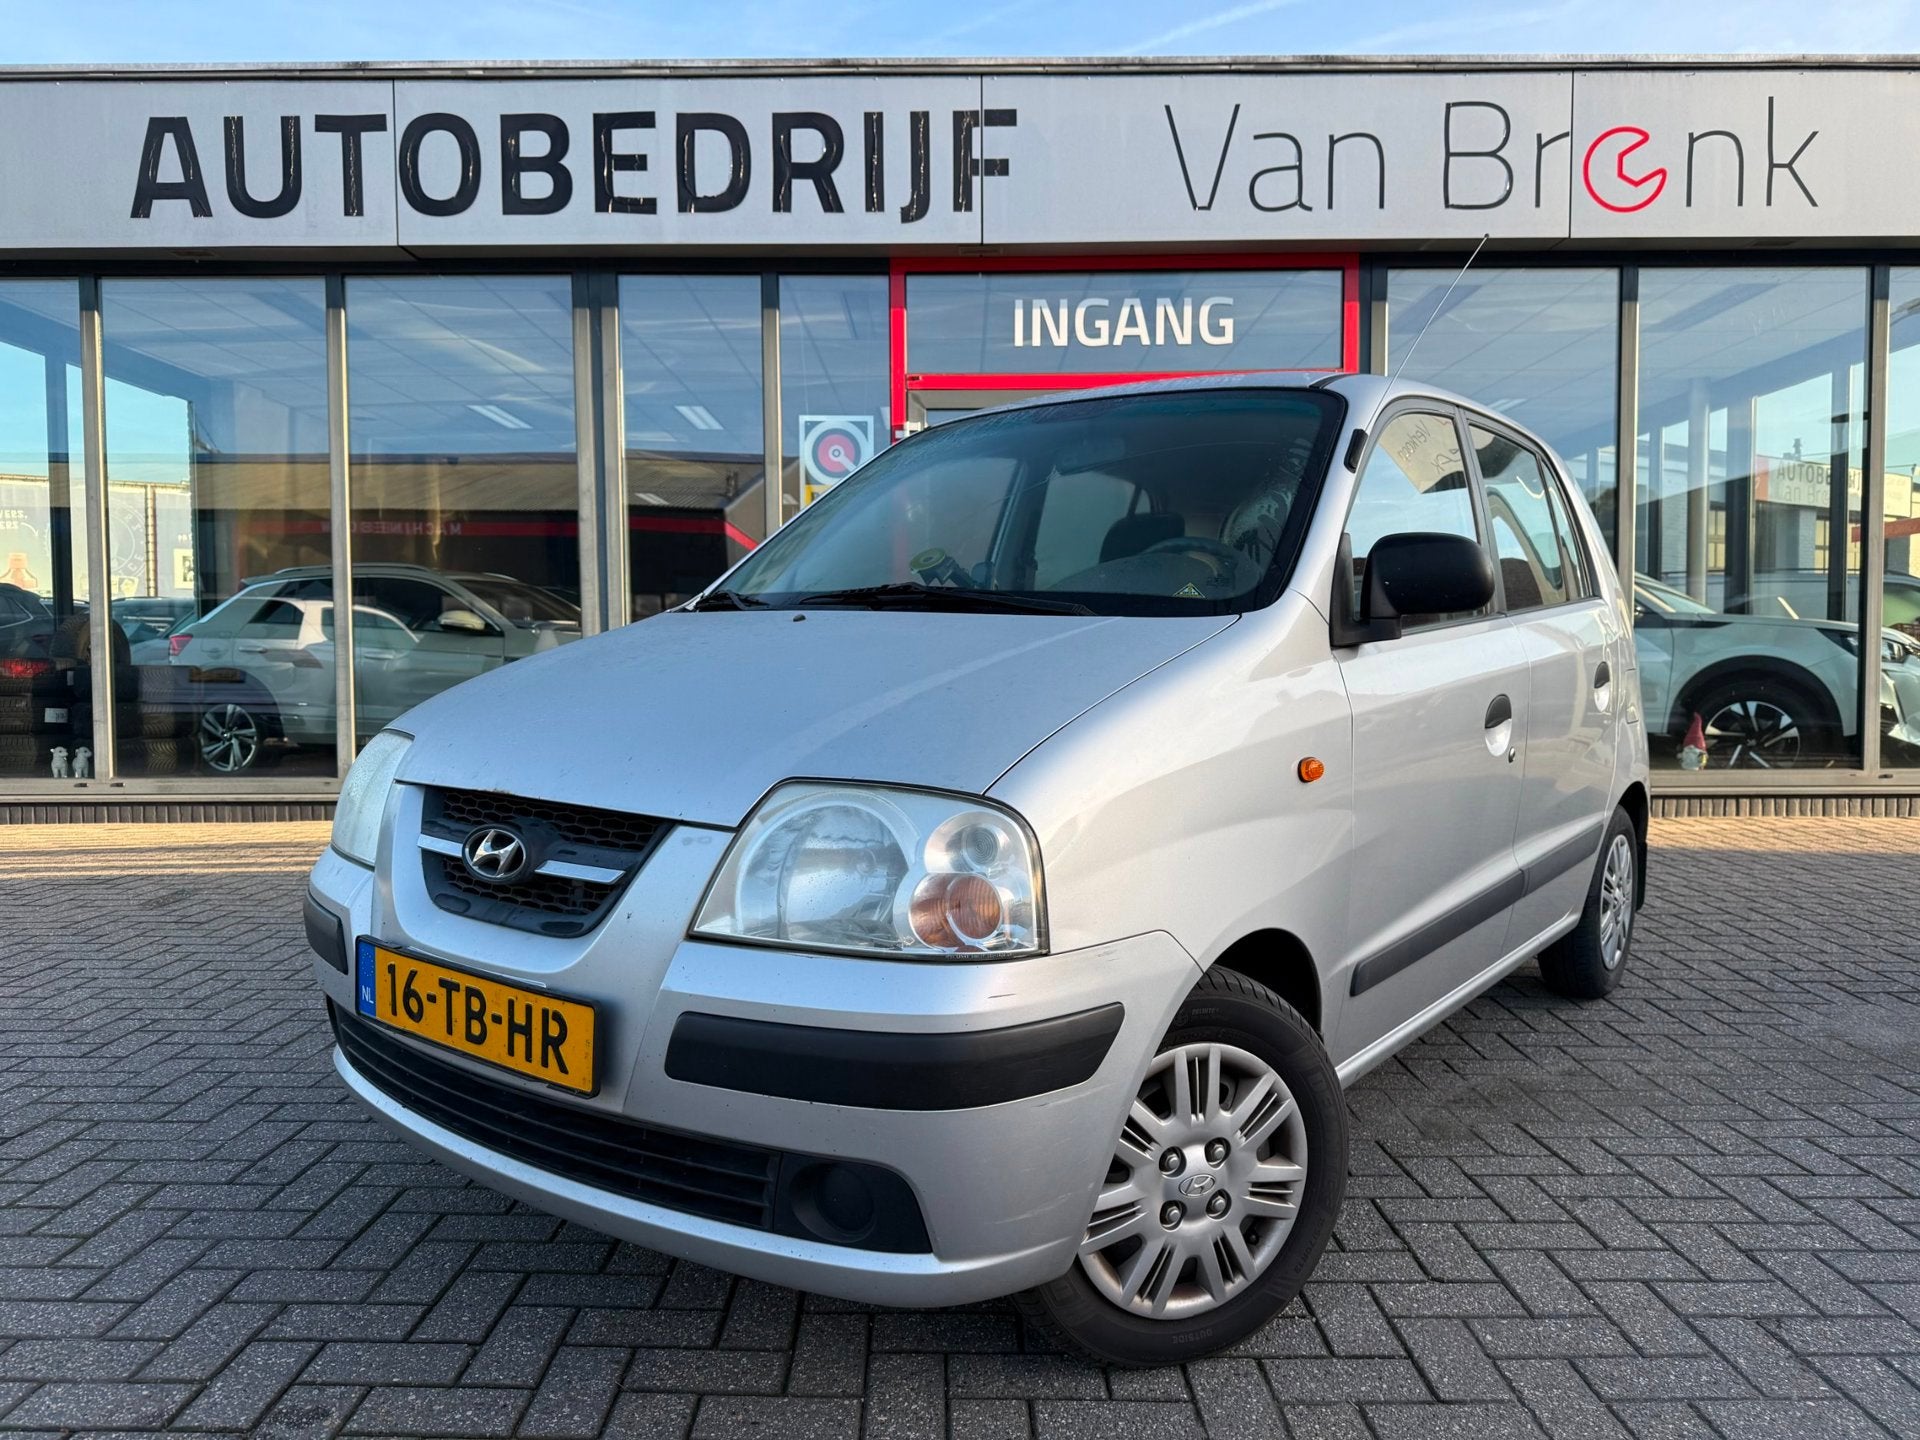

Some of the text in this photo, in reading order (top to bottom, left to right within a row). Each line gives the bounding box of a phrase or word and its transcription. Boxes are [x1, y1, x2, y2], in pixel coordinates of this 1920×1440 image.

[131, 109, 1017, 224] AUTOBEDRIJF
[1165, 103, 1386, 212] Van
[1014, 297, 1234, 347] INGANG
[361, 961, 570, 1075] NL 16-TB-HR
